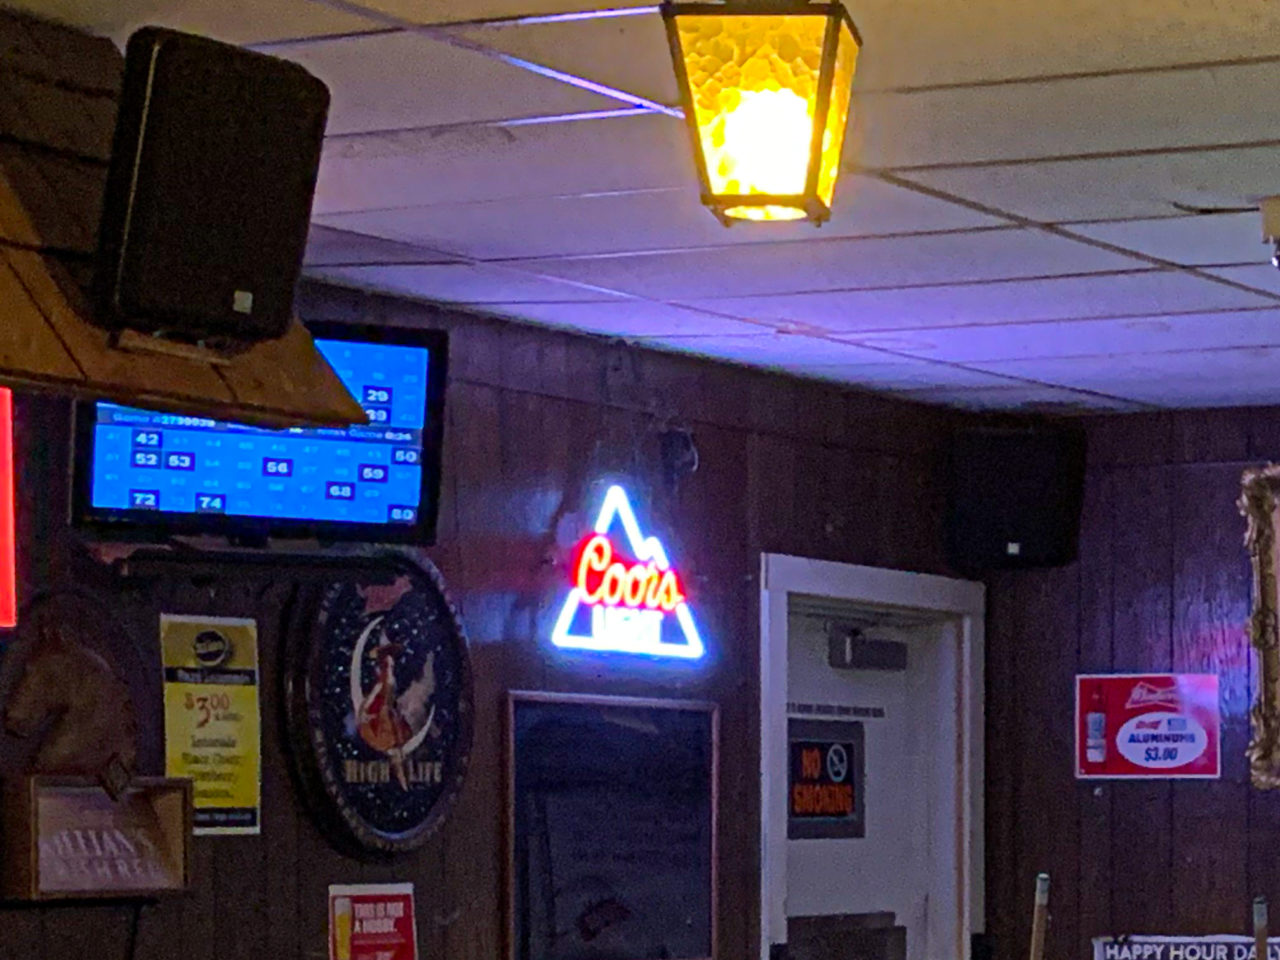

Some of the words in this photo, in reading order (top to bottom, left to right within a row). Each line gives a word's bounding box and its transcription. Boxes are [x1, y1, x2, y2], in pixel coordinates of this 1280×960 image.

[367, 390, 388, 401] 29
[136, 433, 159, 445] 42
[267, 461, 289, 473] 56
[330, 485, 352, 497] 68
[133, 493, 156, 506] 72
[200, 497, 222, 509] 74
[579, 534, 683, 610] Coors
[803, 746, 822, 780] NO
[344, 759, 390, 784] HIGH
[407, 759, 443, 784] LIFE
[793, 782, 855, 815] SMOKING
[1104, 944, 1165, 960] HAPPY
